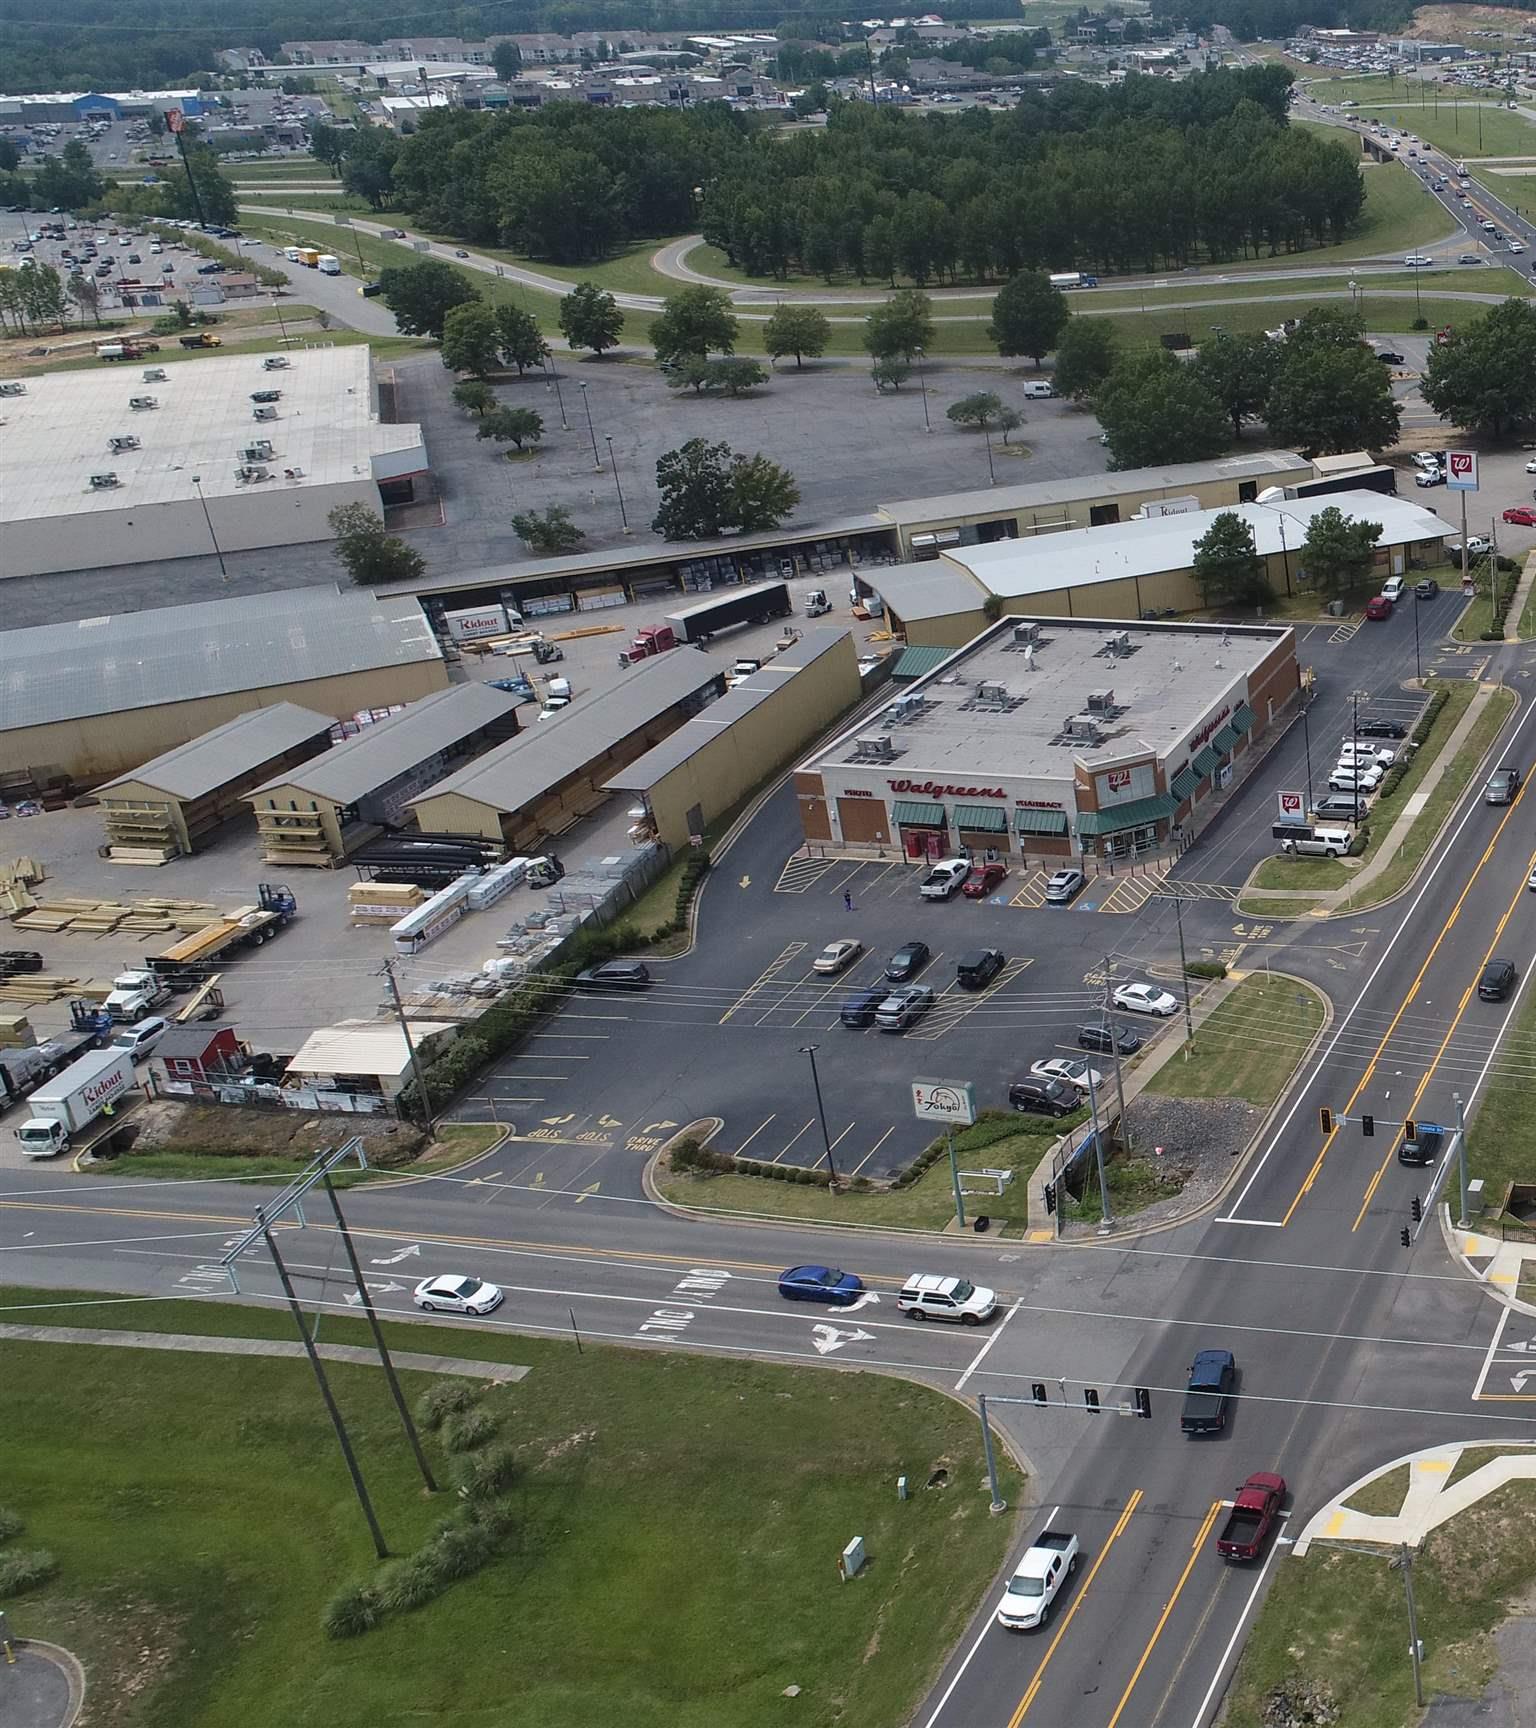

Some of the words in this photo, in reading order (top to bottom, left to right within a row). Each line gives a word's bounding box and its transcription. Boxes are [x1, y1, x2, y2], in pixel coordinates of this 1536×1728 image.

[1160, 506, 1188, 517] Ridout
[456, 618, 498, 630] Ridout
[844, 789, 873, 798] PHOTO
[887, 779, 1008, 799] Walgreens
[1015, 800, 1063, 809] PHARMACY
[79, 1070, 123, 1107] Ridout
[925, 1100, 959, 1112] Tokyo
[527, 1128, 562, 1138] STOP
[576, 1130, 612, 1141] STOP
[627, 1136, 664, 1145] DRIVE
[624, 1143, 657, 1151] THRU
